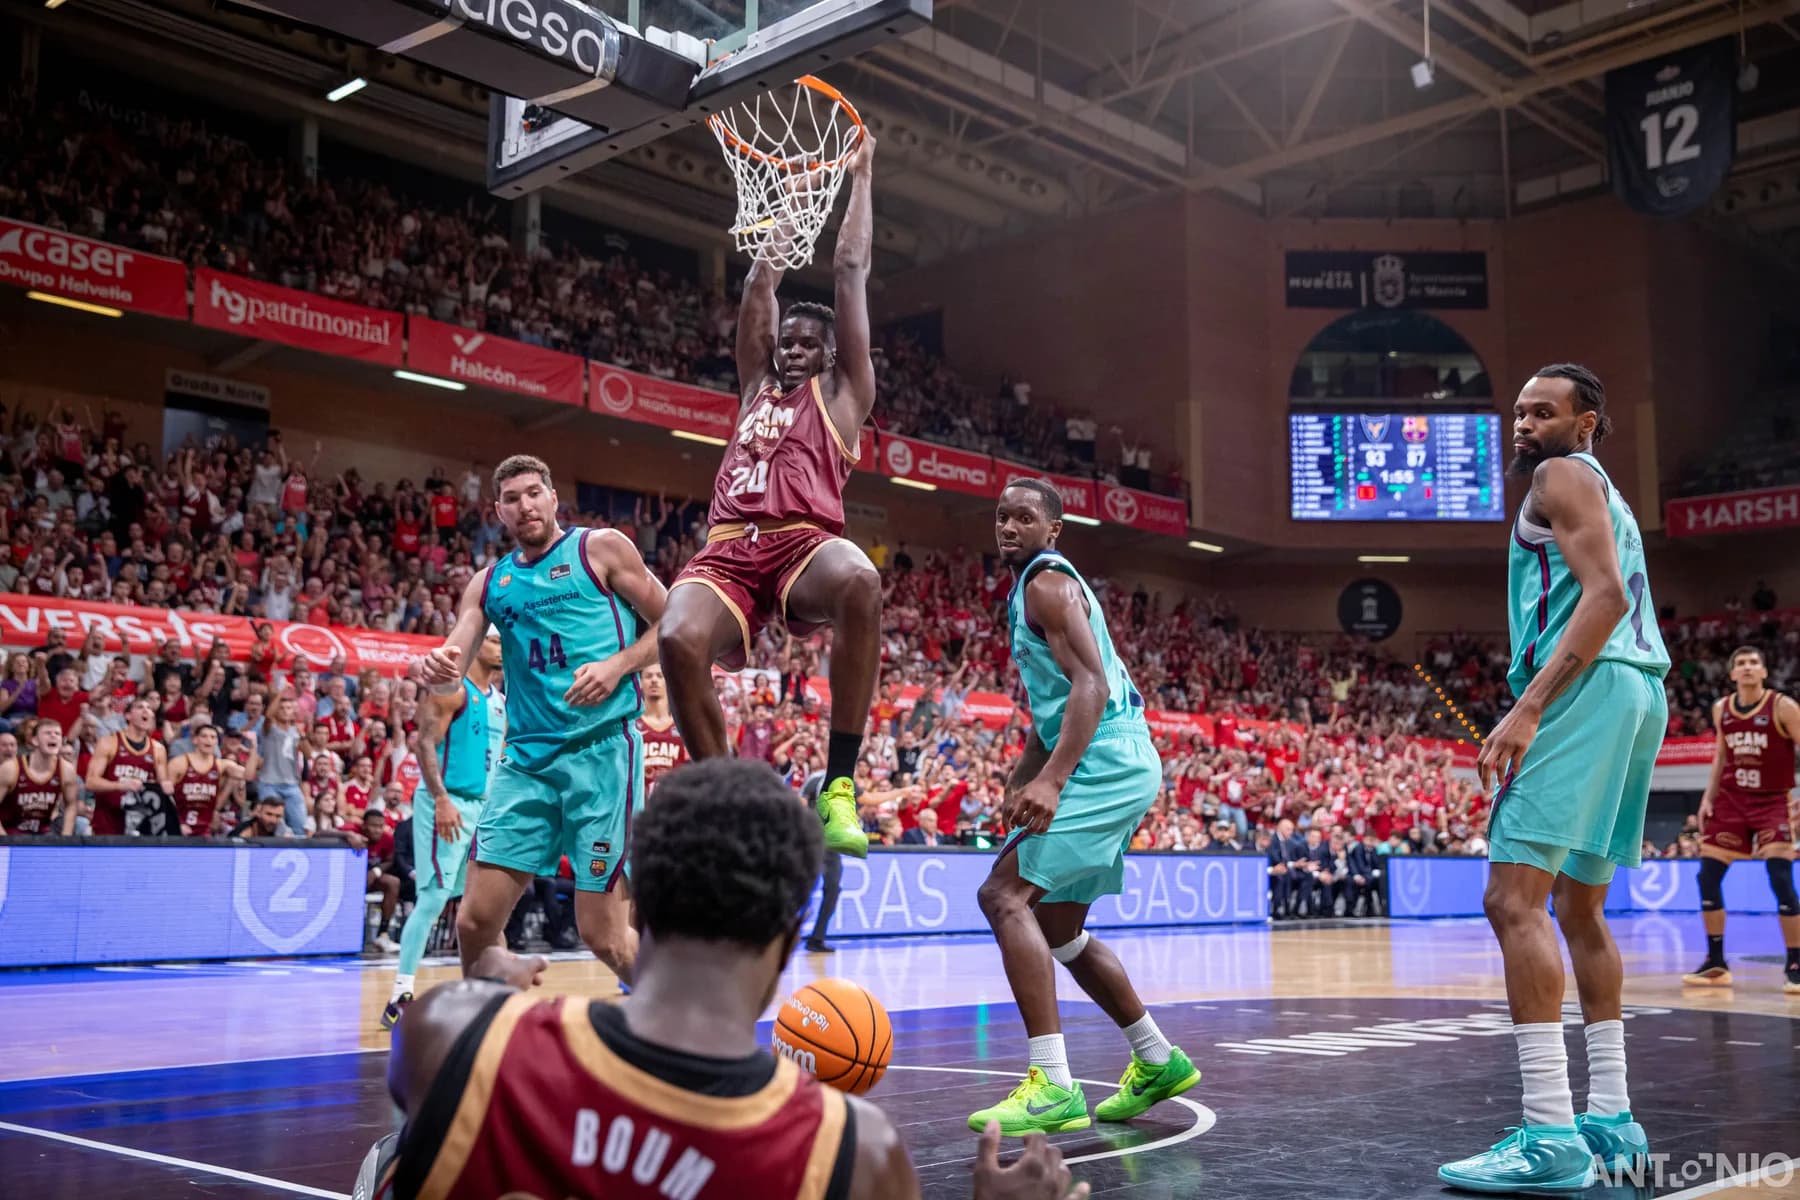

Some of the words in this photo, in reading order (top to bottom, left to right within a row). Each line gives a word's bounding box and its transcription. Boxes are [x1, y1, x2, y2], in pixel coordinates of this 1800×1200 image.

[1640, 104, 1701, 169] 12
[25, 231, 134, 279] caser
[59, 273, 133, 302] Helvetia
[451, 355, 516, 387] Halcón
[727, 460, 770, 497] 20
[1686, 494, 1798, 530] MARSH
[529, 633, 568, 674] 44
[1725, 731, 1768, 749] UCAM
[1735, 768, 1761, 788] 99
[268, 849, 310, 913] 2
[803, 857, 948, 930] RAS
[1641, 861, 1661, 892] 2
[571, 1108, 716, 1200] BOUM
